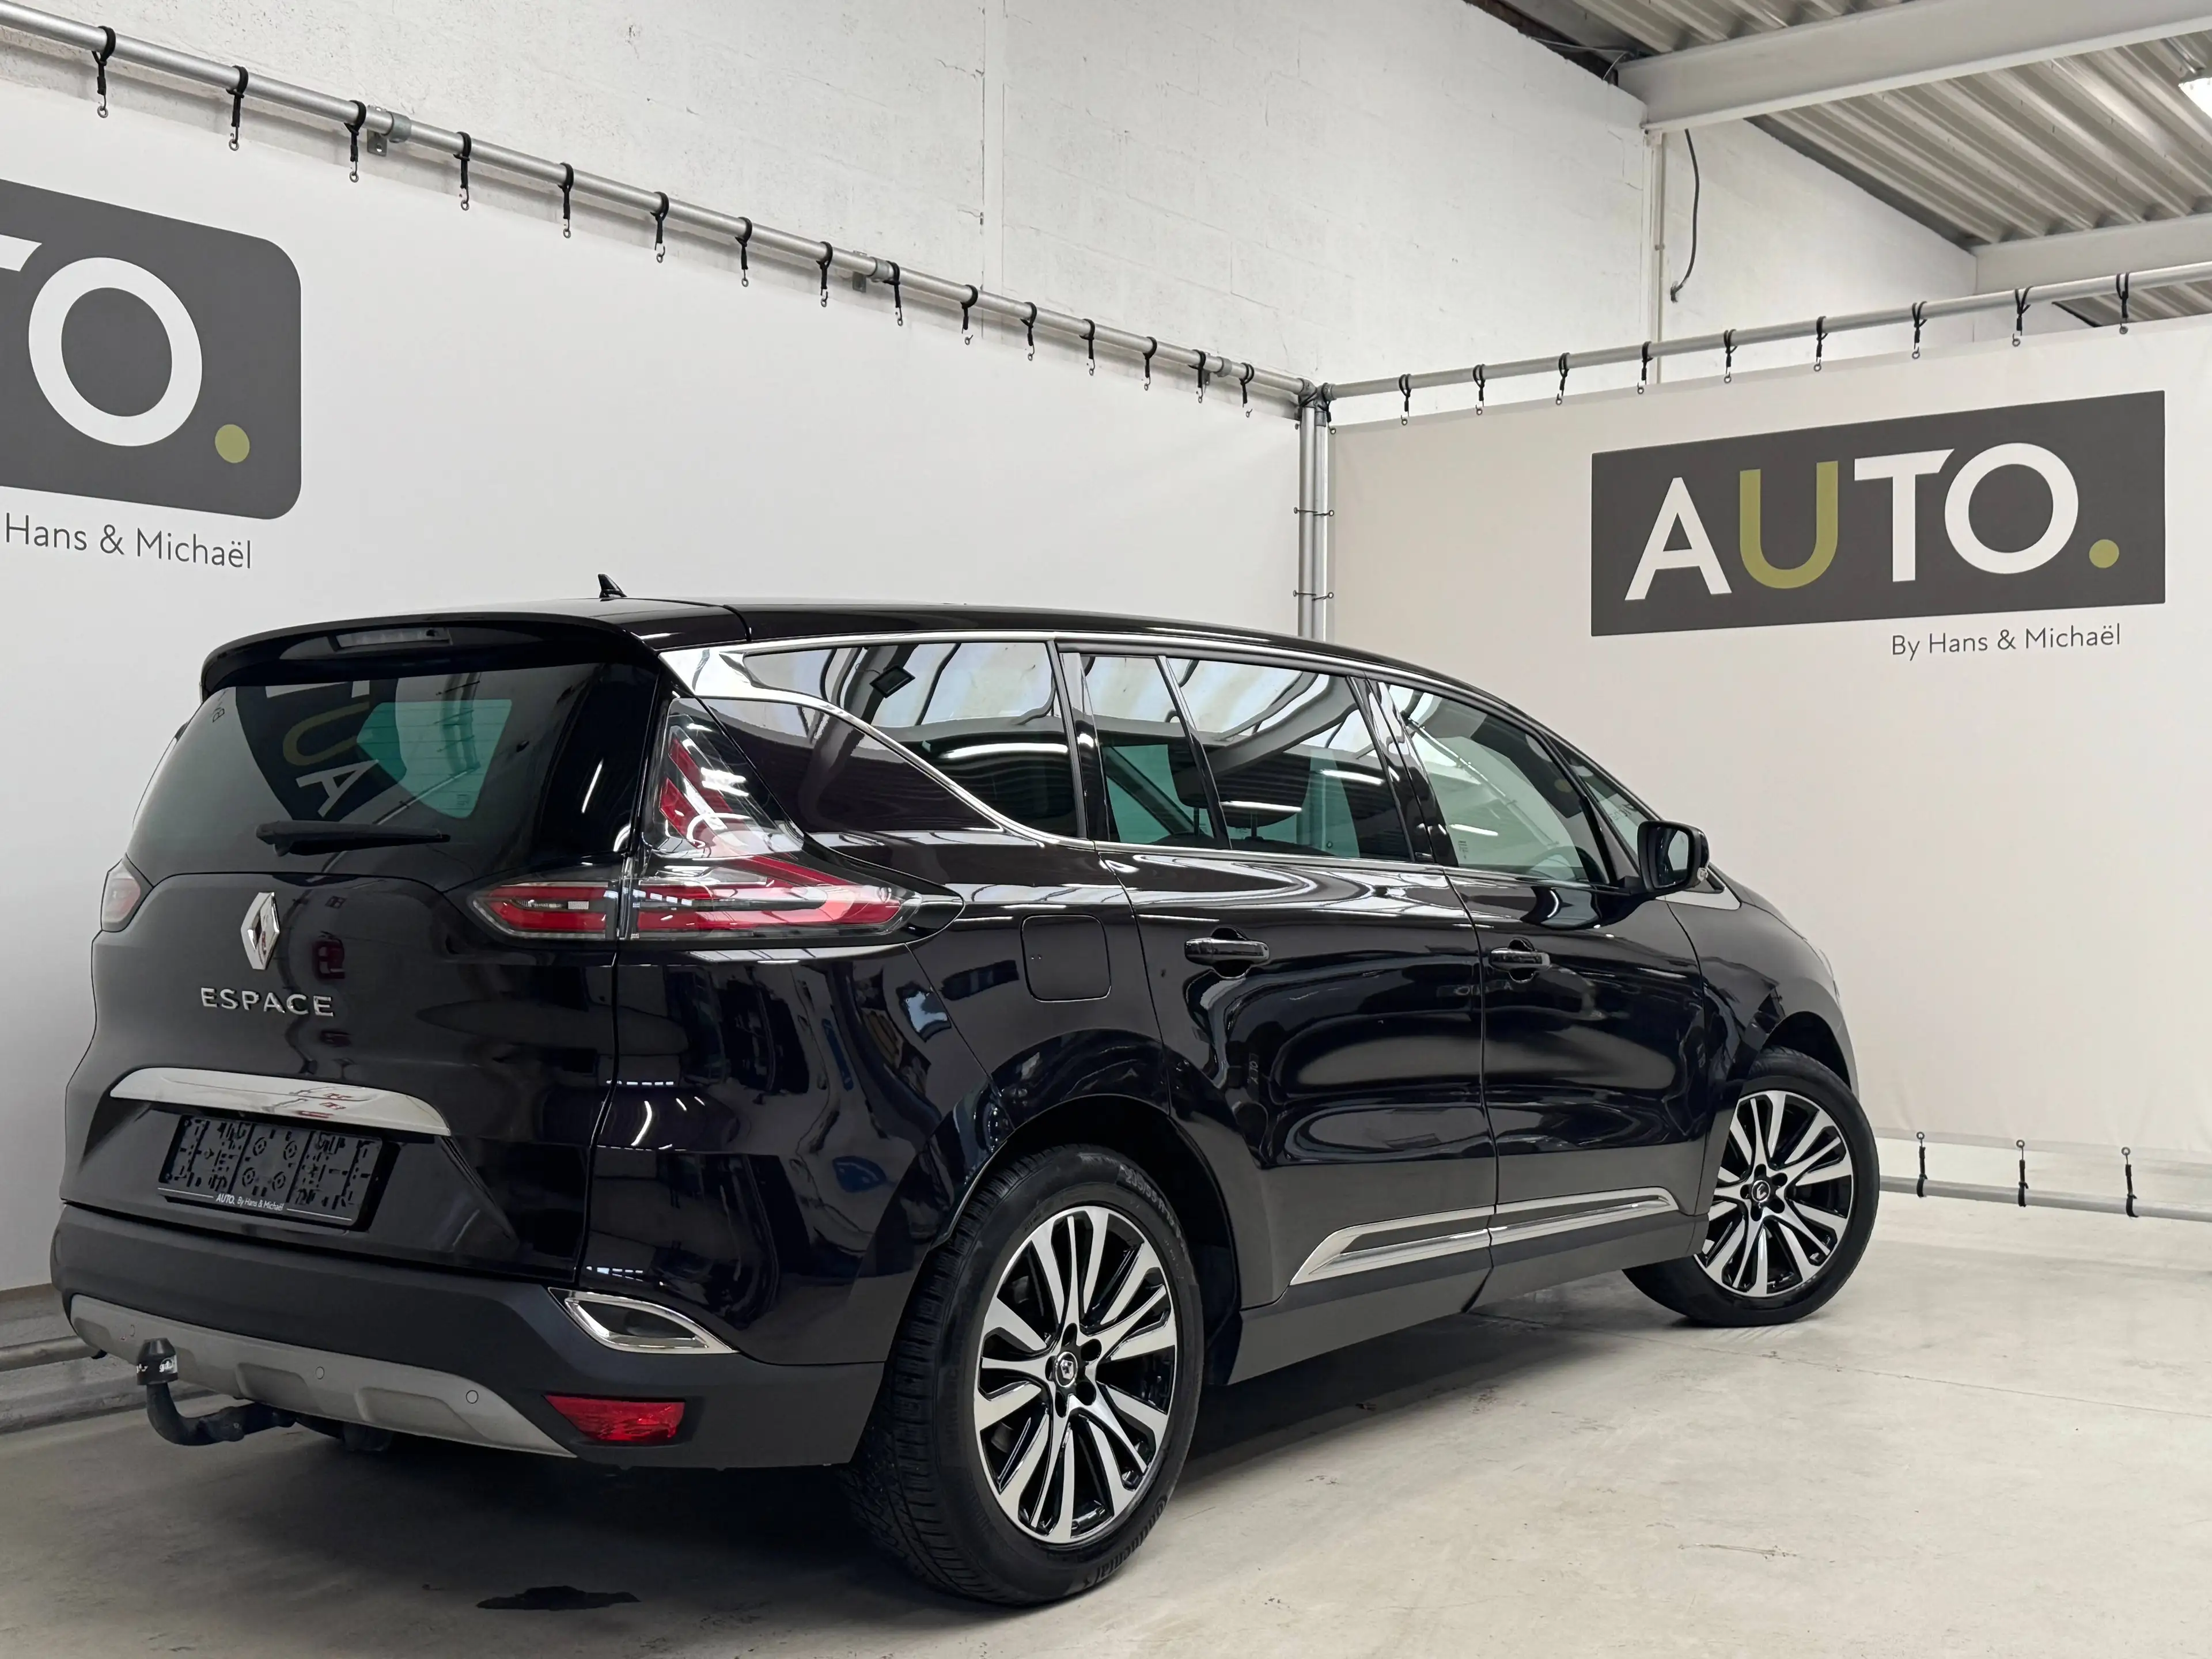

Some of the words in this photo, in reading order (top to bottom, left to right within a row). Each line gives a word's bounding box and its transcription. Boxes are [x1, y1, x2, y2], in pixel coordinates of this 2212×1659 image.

[0, 234, 250, 463] O.
[6, 512, 88, 551] Hans
[100, 524, 125, 555] &
[137, 527, 251, 569] Michaël
[1624, 442, 2120, 601] AUTO.
[1892, 634, 1921, 661] By
[1929, 632, 1988, 654] Hans
[1997, 629, 2017, 650] &
[2025, 623, 2120, 649] Michaël
[201, 987, 334, 1017] ESPACE
[237, 1196, 245, 1207] By
[245, 1198, 257, 1207] Hans
[257, 1199, 263, 1208] &
